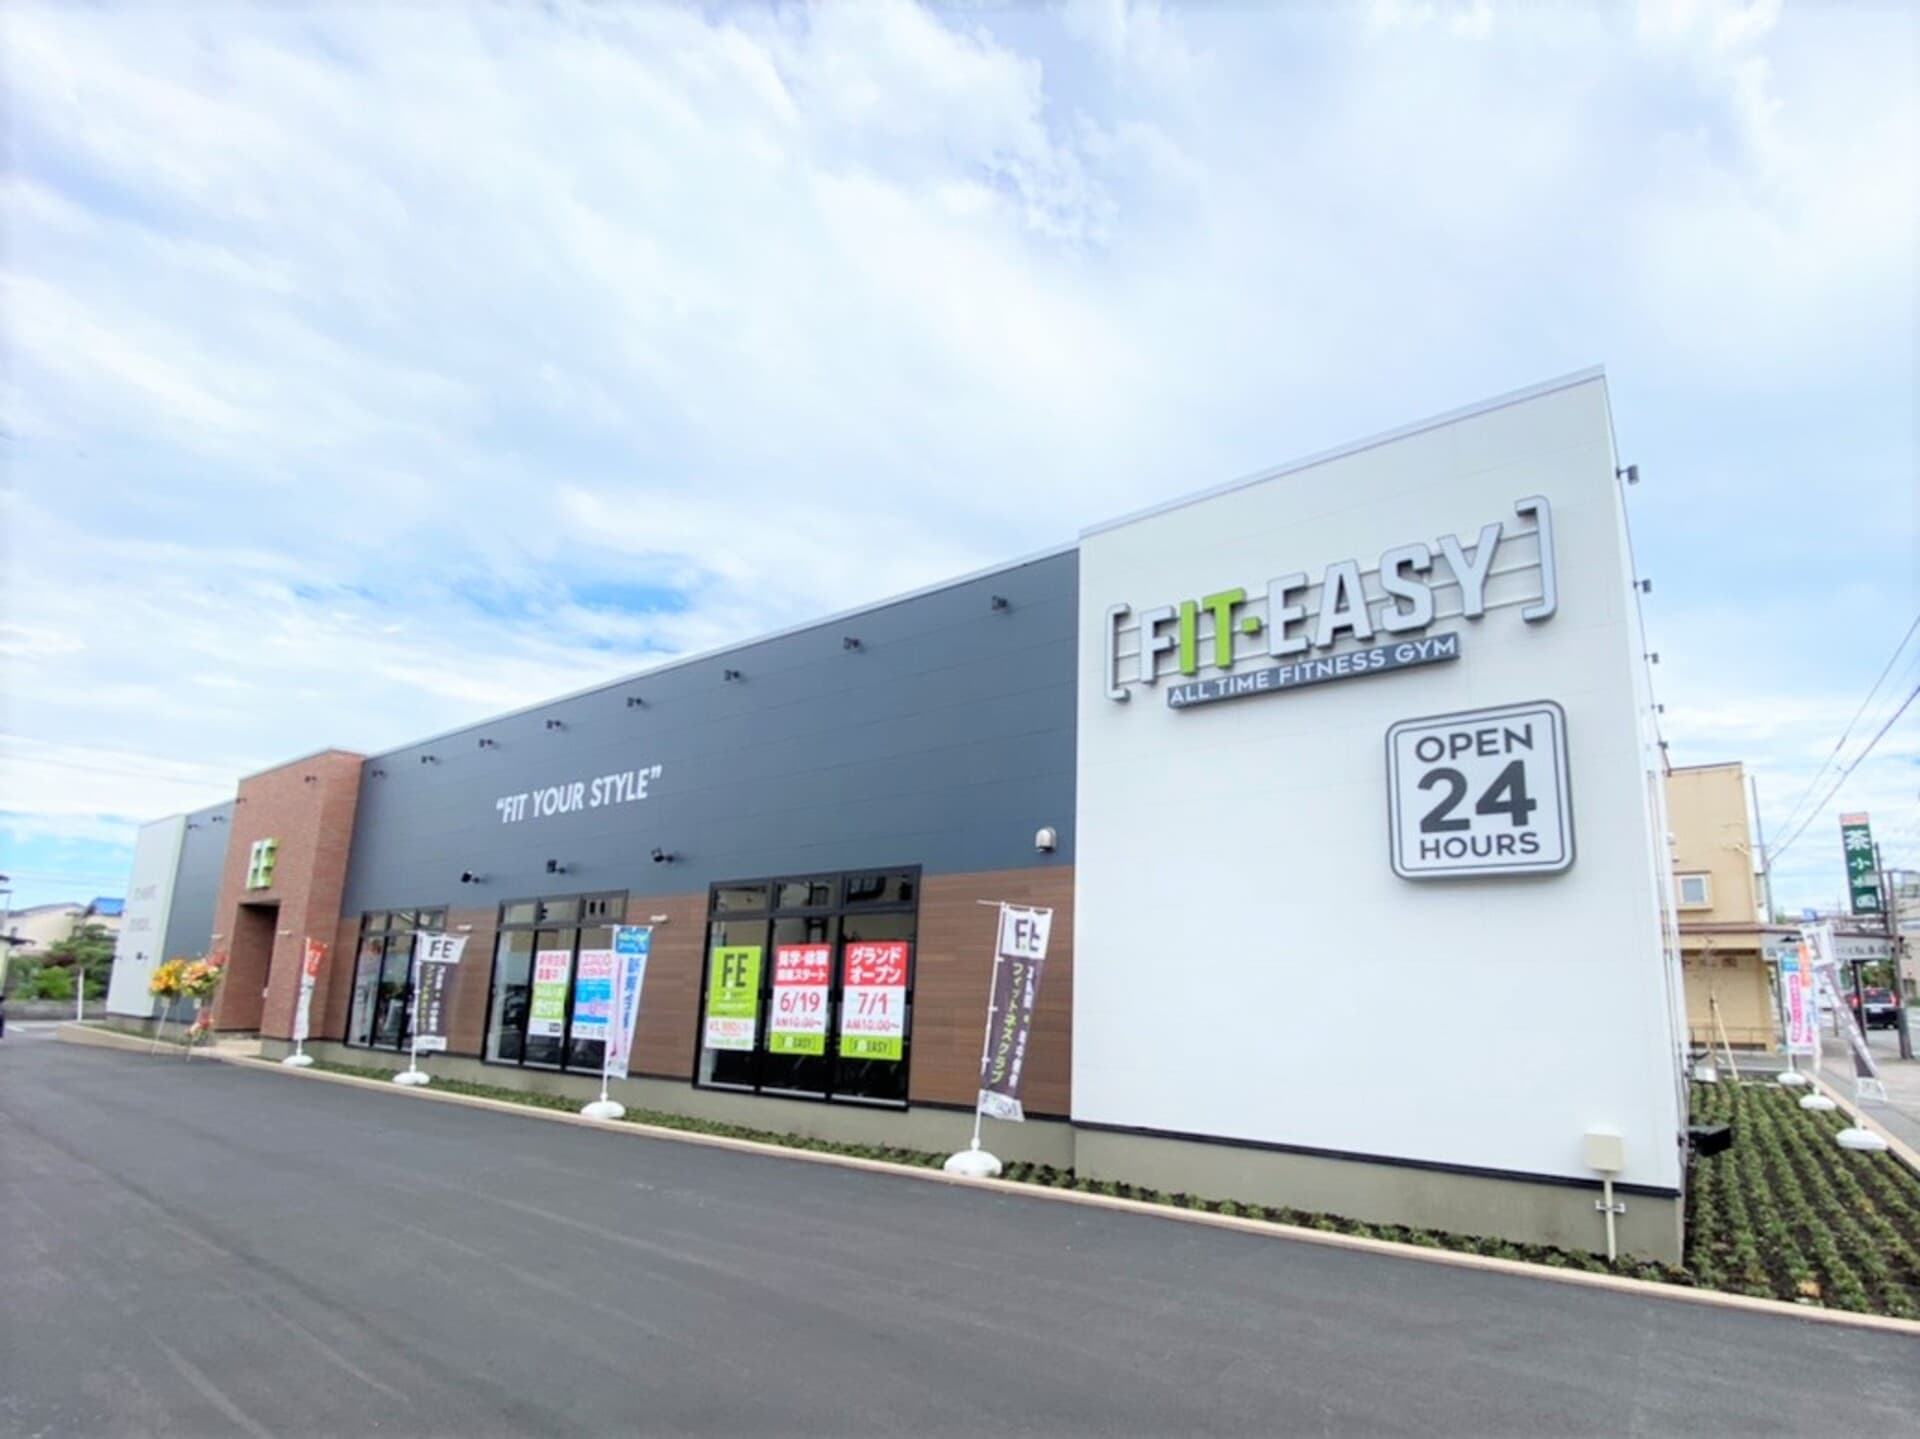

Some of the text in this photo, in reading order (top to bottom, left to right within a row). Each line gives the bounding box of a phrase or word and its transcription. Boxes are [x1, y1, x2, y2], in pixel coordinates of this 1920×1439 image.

[1169, 637, 1456, 705] ALL TIME FITNESS GYM
[1415, 723, 1534, 762] OPEN
[533, 781, 585, 817] YOUR
[1417, 760, 1537, 834] 24
[1420, 832, 1540, 860] HOURS
[429, 940, 455, 959] FE
[850, 945, 902, 966] グランド
[722, 953, 749, 988] FE
[848, 964, 902, 984] オープン
[780, 991, 821, 1014] 6/19
[857, 991, 888, 1016] 7/1
